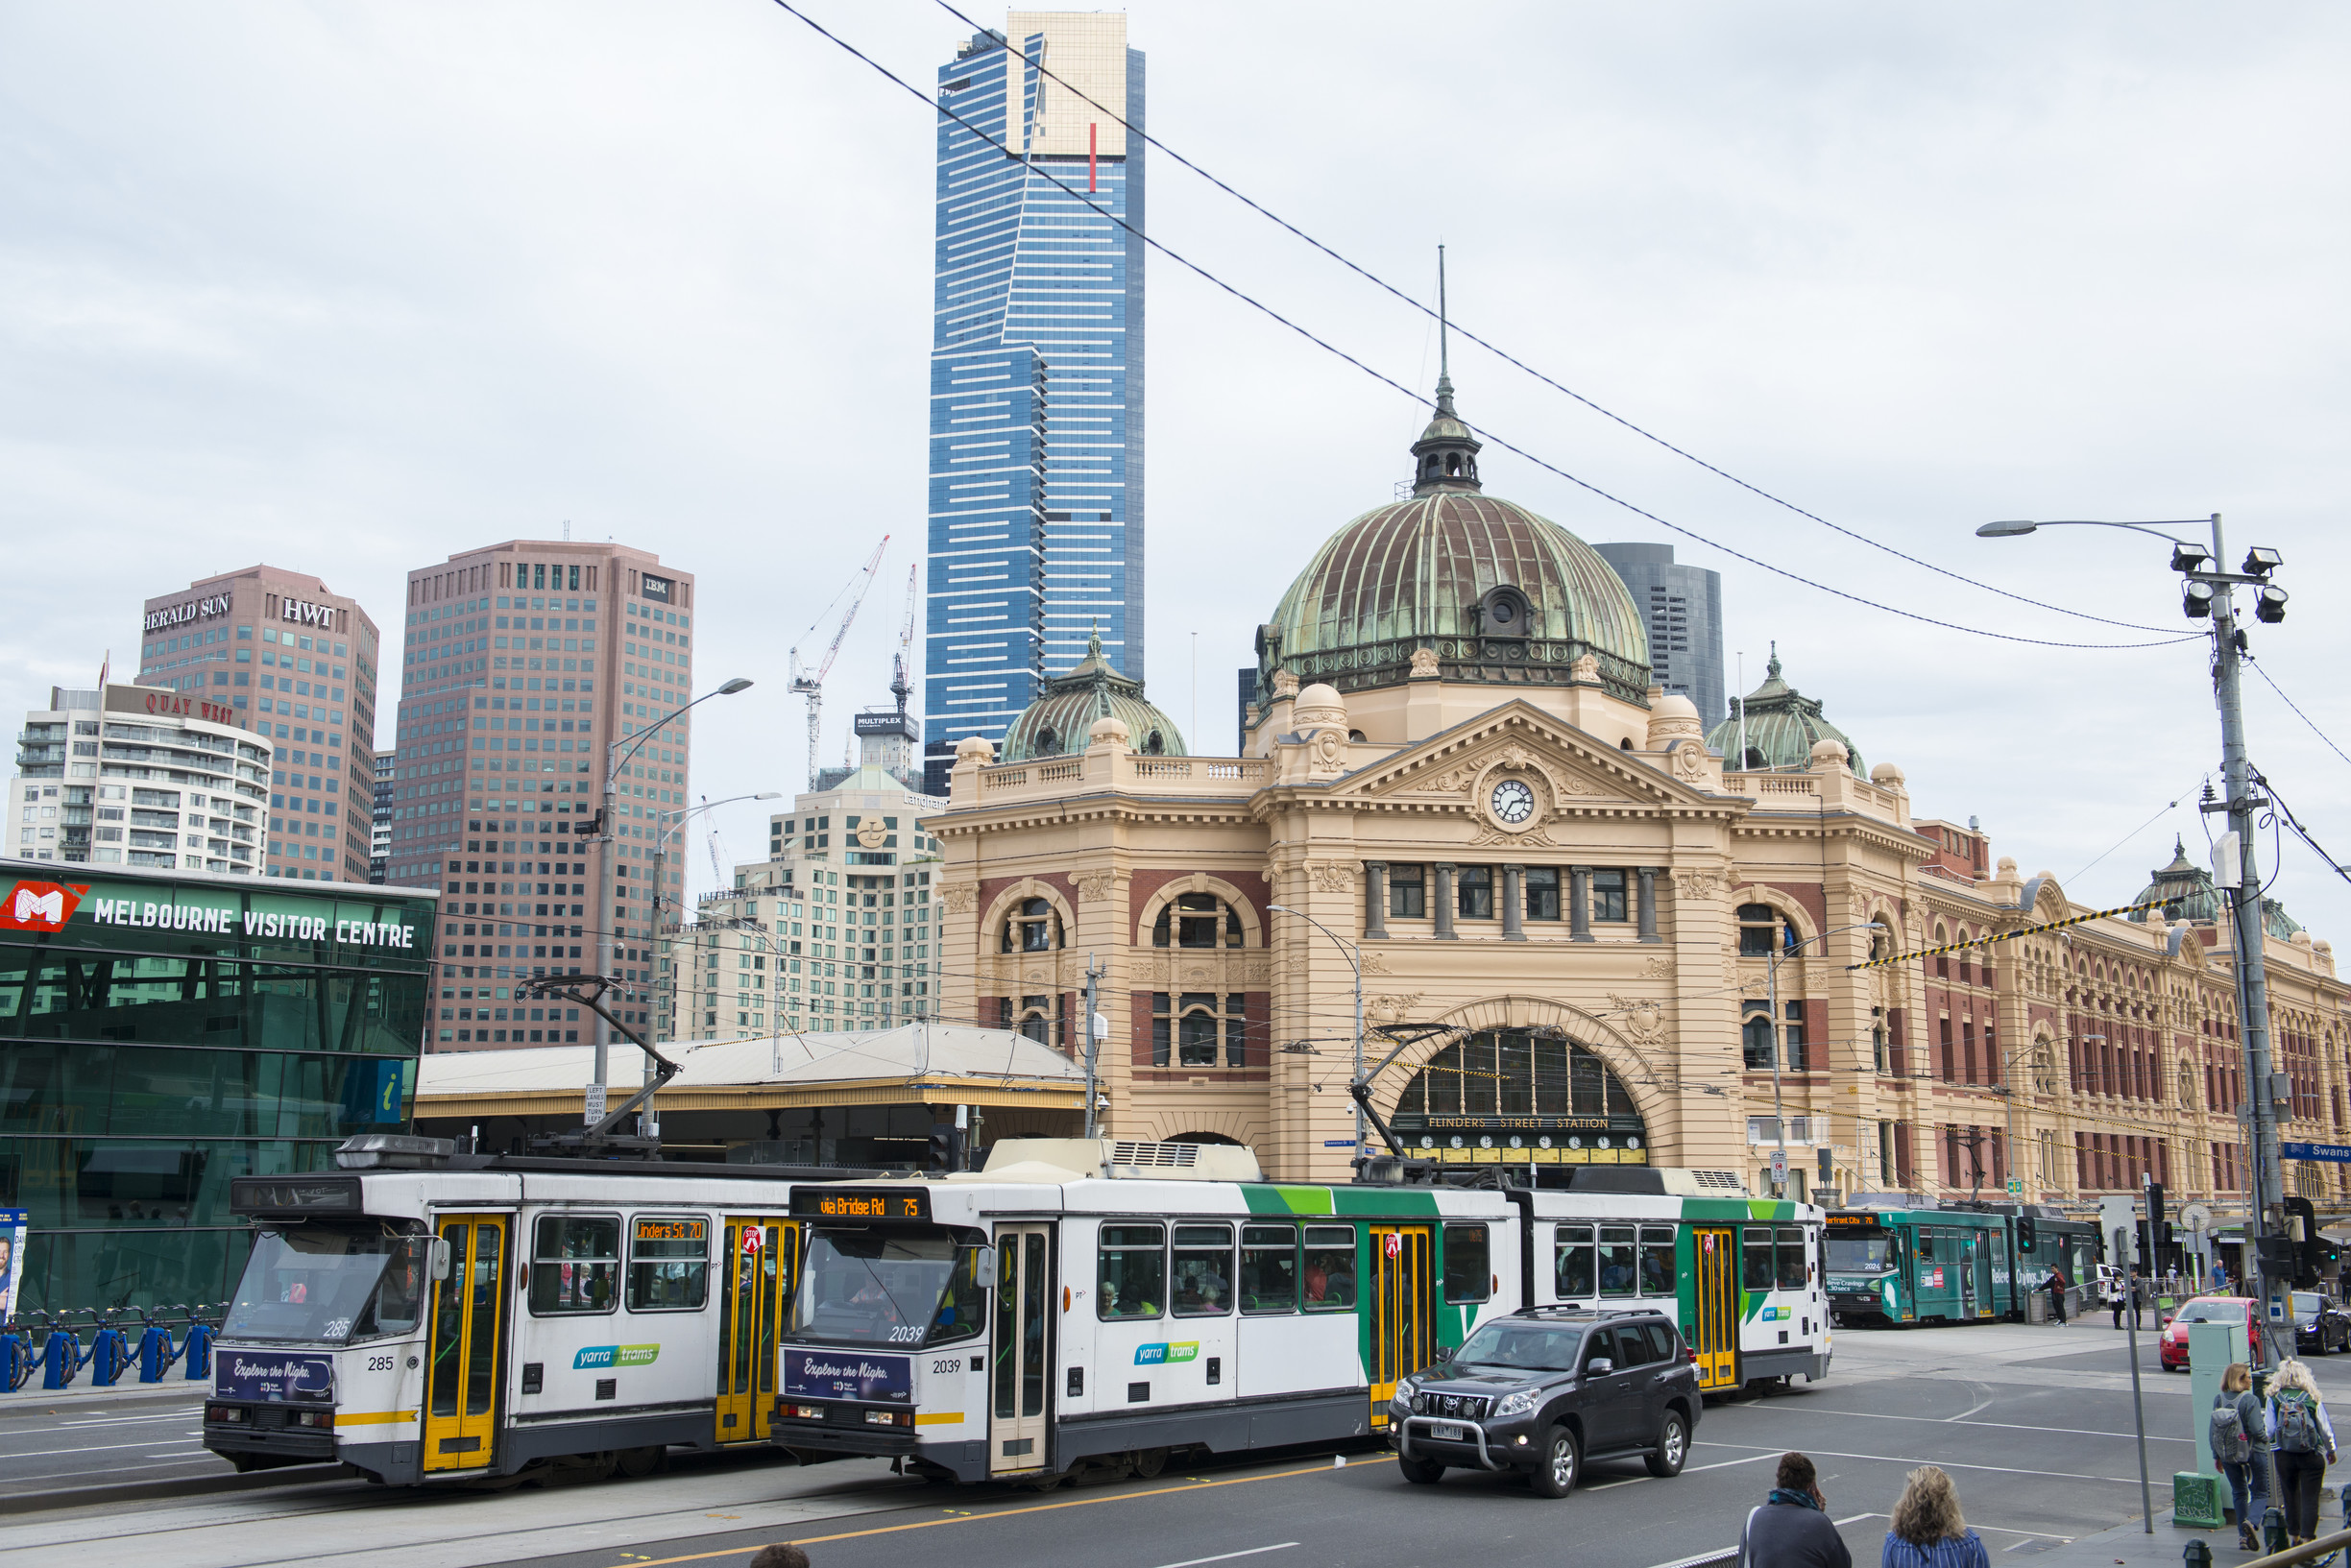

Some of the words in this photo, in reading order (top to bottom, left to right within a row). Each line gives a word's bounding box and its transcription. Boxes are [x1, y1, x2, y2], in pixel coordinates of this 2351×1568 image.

[645, 578, 667, 593] IBM
[143, 604, 197, 631] HERALD
[201, 594, 230, 617] SUN
[283, 598, 335, 627] HWT
[145, 692, 192, 714] QUAY
[201, 701, 232, 726] WEST
[94, 898, 231, 934] MELBOURNE
[244, 911, 327, 942] VISITOR
[336, 919, 415, 949] CENTRE
[1428, 1118, 1486, 1128] FLINDERS
[1500, 1118, 1543, 1128] STREET
[1557, 1118, 1609, 1128] STATION
[2313, 1145, 2351, 1158] Swans
[820, 1197, 836, 1215] via
[837, 1197, 869, 1216] Bridge
[871, 1197, 885, 1216] Rd
[903, 1198, 918, 1217] 75
[1849, 1216, 1860, 1224] City
[672, 1222, 685, 1239] St
[690, 1222, 702, 1239] 70
[1991, 1268, 2009, 1284] Relieve
[323, 1320, 351, 1338] 285
[888, 1325, 925, 1342] 2039
[580, 1350, 611, 1366] yarra
[621, 1348, 654, 1361] trams
[1139, 1347, 1162, 1363] yarra
[1170, 1345, 1195, 1358] trams
[234, 1358, 269, 1380] Explore
[269, 1365, 283, 1378] the
[283, 1361, 310, 1380] Night.
[368, 1357, 394, 1371] 285
[804, 1357, 842, 1379] Explore
[842, 1364, 858, 1377] the
[859, 1362, 888, 1382] Night.
[933, 1359, 961, 1374] 2039
[1450, 1427, 1462, 1436] 188
